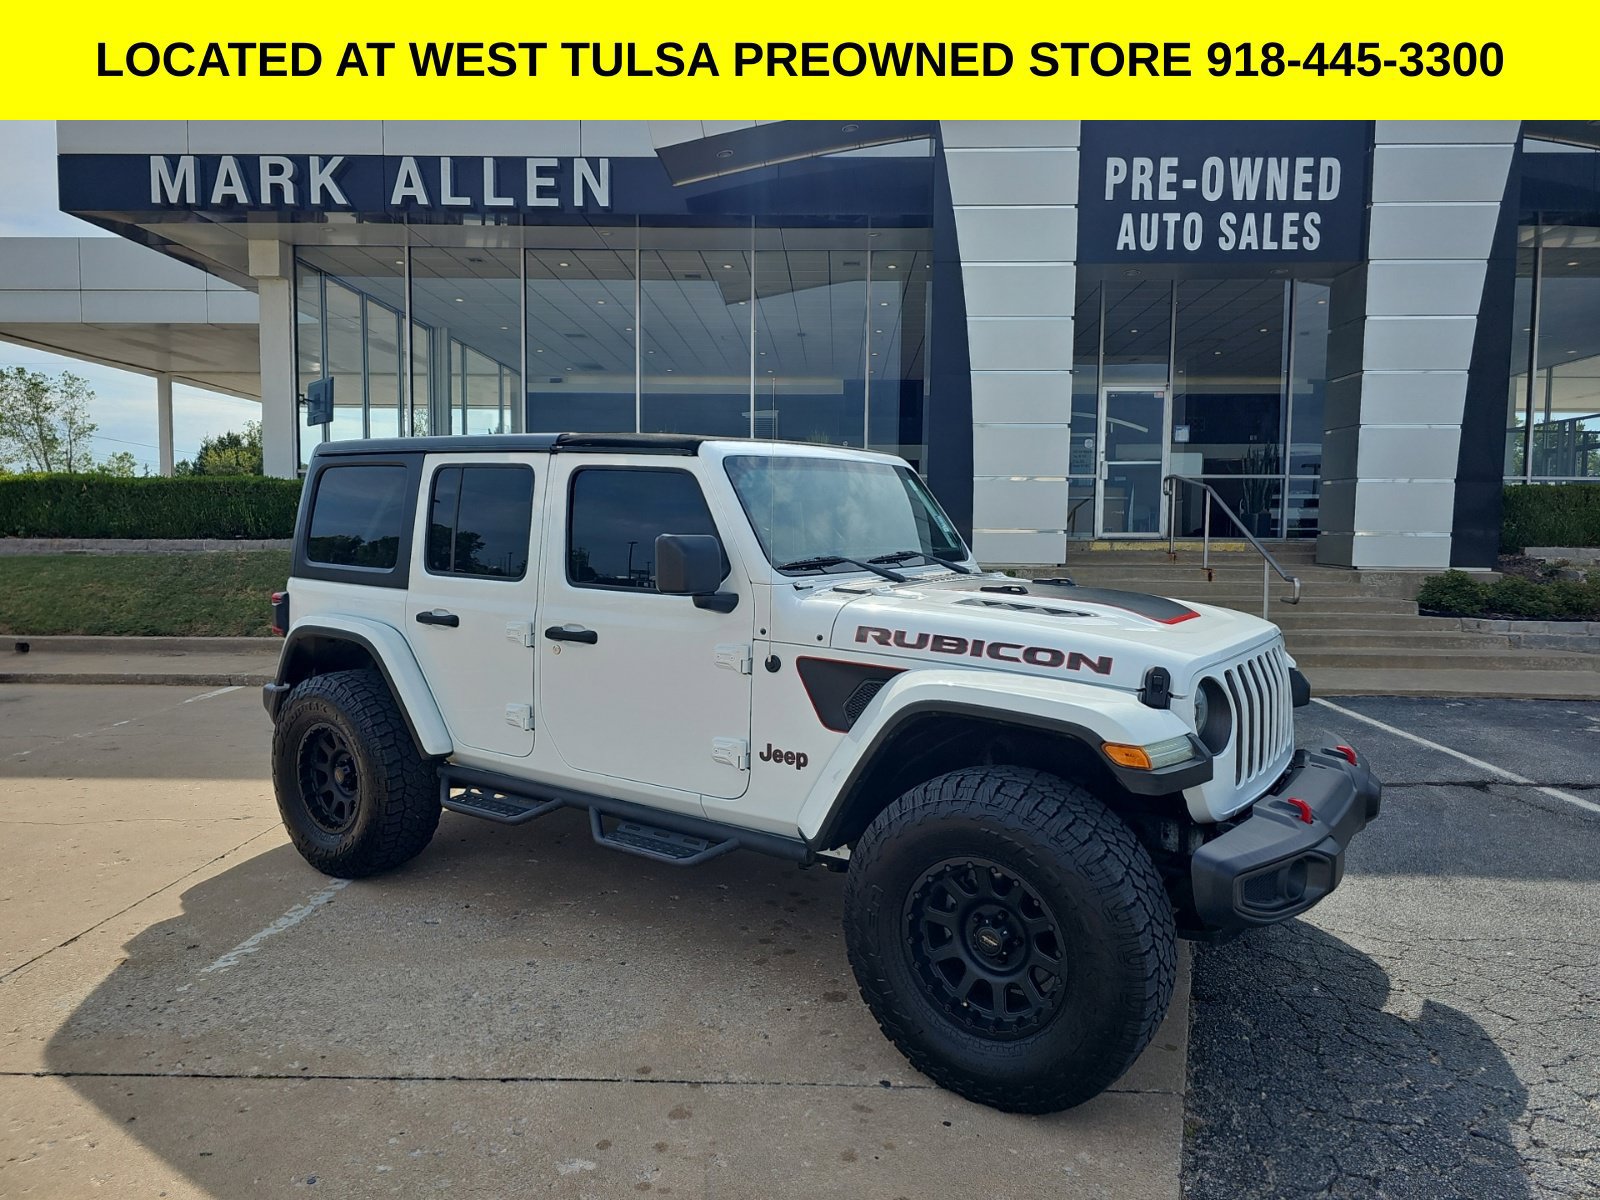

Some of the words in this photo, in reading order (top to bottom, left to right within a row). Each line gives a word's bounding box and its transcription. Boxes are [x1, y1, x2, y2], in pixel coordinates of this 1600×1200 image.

[150, 155, 350, 205] MARK
[390, 156, 610, 207] ALLEN
[1105, 156, 1341, 201] PRE-OWNED
[1116, 212, 1203, 250] AUTO
[1218, 212, 1321, 250] SALES
[855, 625, 1113, 675] RUBICON
[759, 743, 808, 770] Jeep
